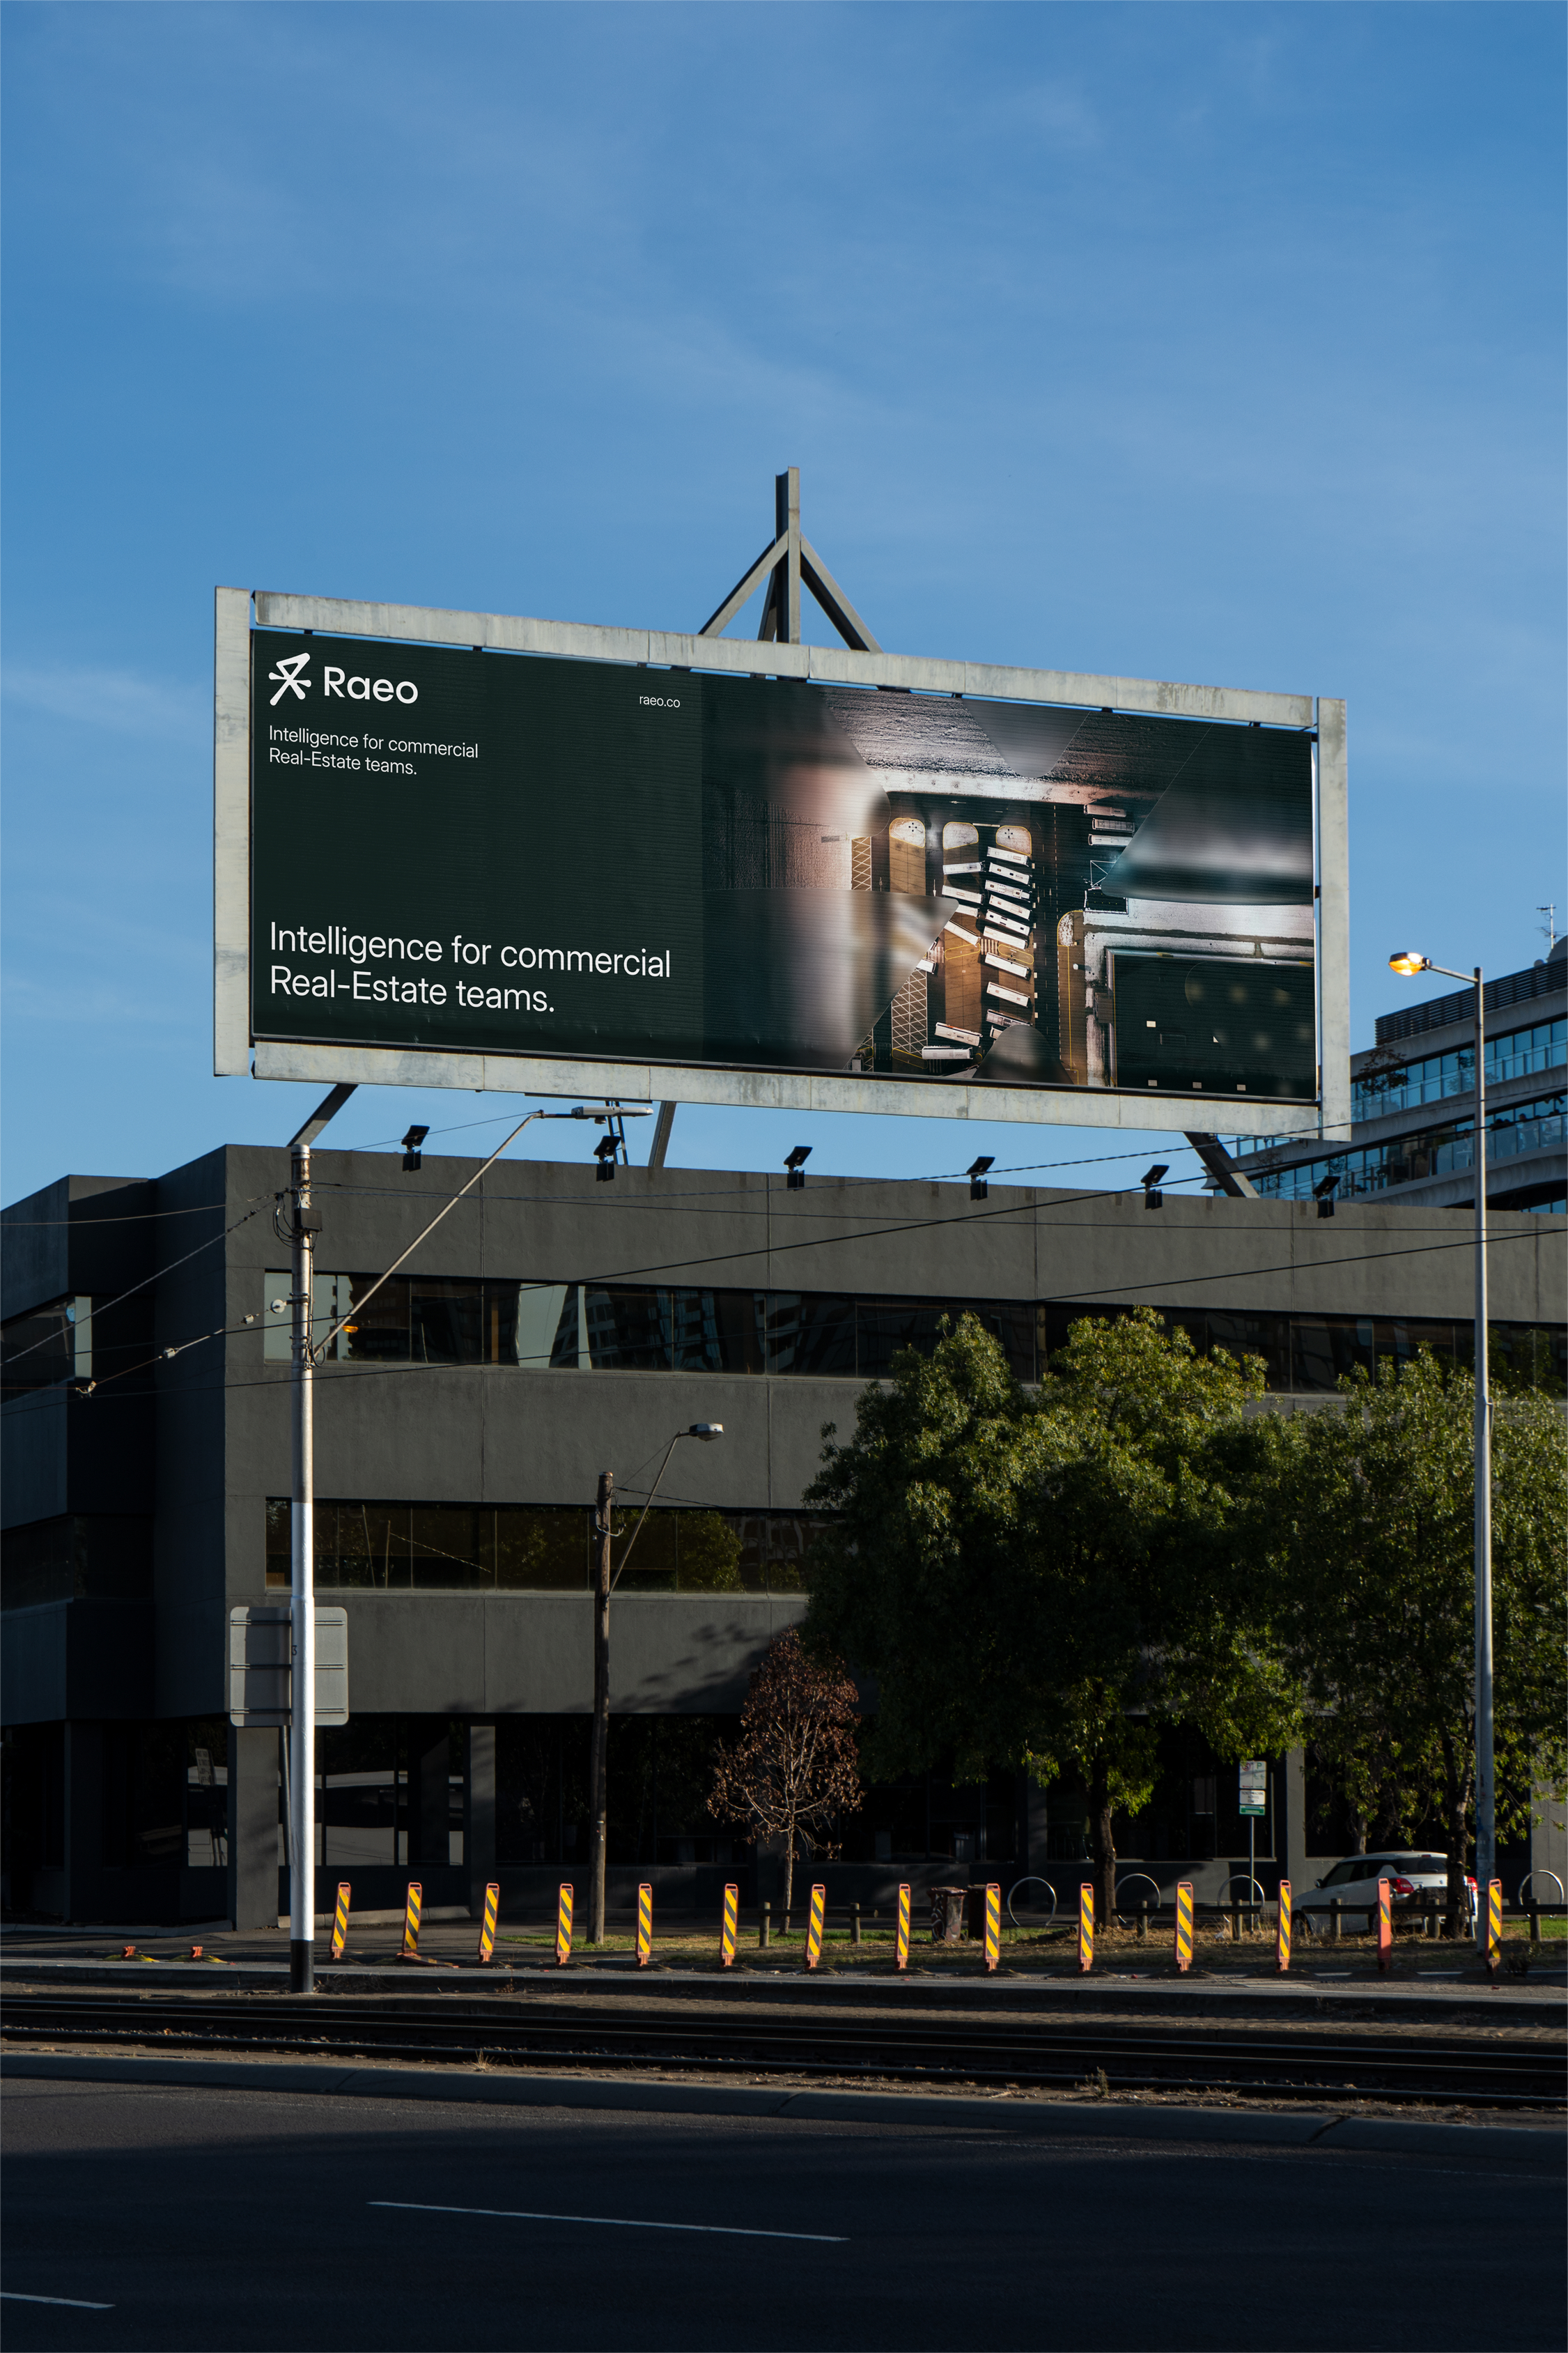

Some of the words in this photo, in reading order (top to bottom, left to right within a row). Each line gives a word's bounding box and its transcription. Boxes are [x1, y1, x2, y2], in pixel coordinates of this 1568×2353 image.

[324, 665, 419, 704] Raeo
[639, 695, 681, 708] raeo.co
[270, 725, 359, 748] Intelligence
[362, 733, 385, 750] for
[388, 739, 479, 758] commercial
[270, 747, 361, 770] Real-Estate
[364, 757, 417, 776] teams.
[271, 921, 443, 964] Intelligence
[451, 934, 492, 965] for
[500, 946, 670, 978] commercial
[271, 965, 447, 1005] Real-Estate
[455, 980, 554, 1012] teams.
[291, 1645, 297, 1656] 3
